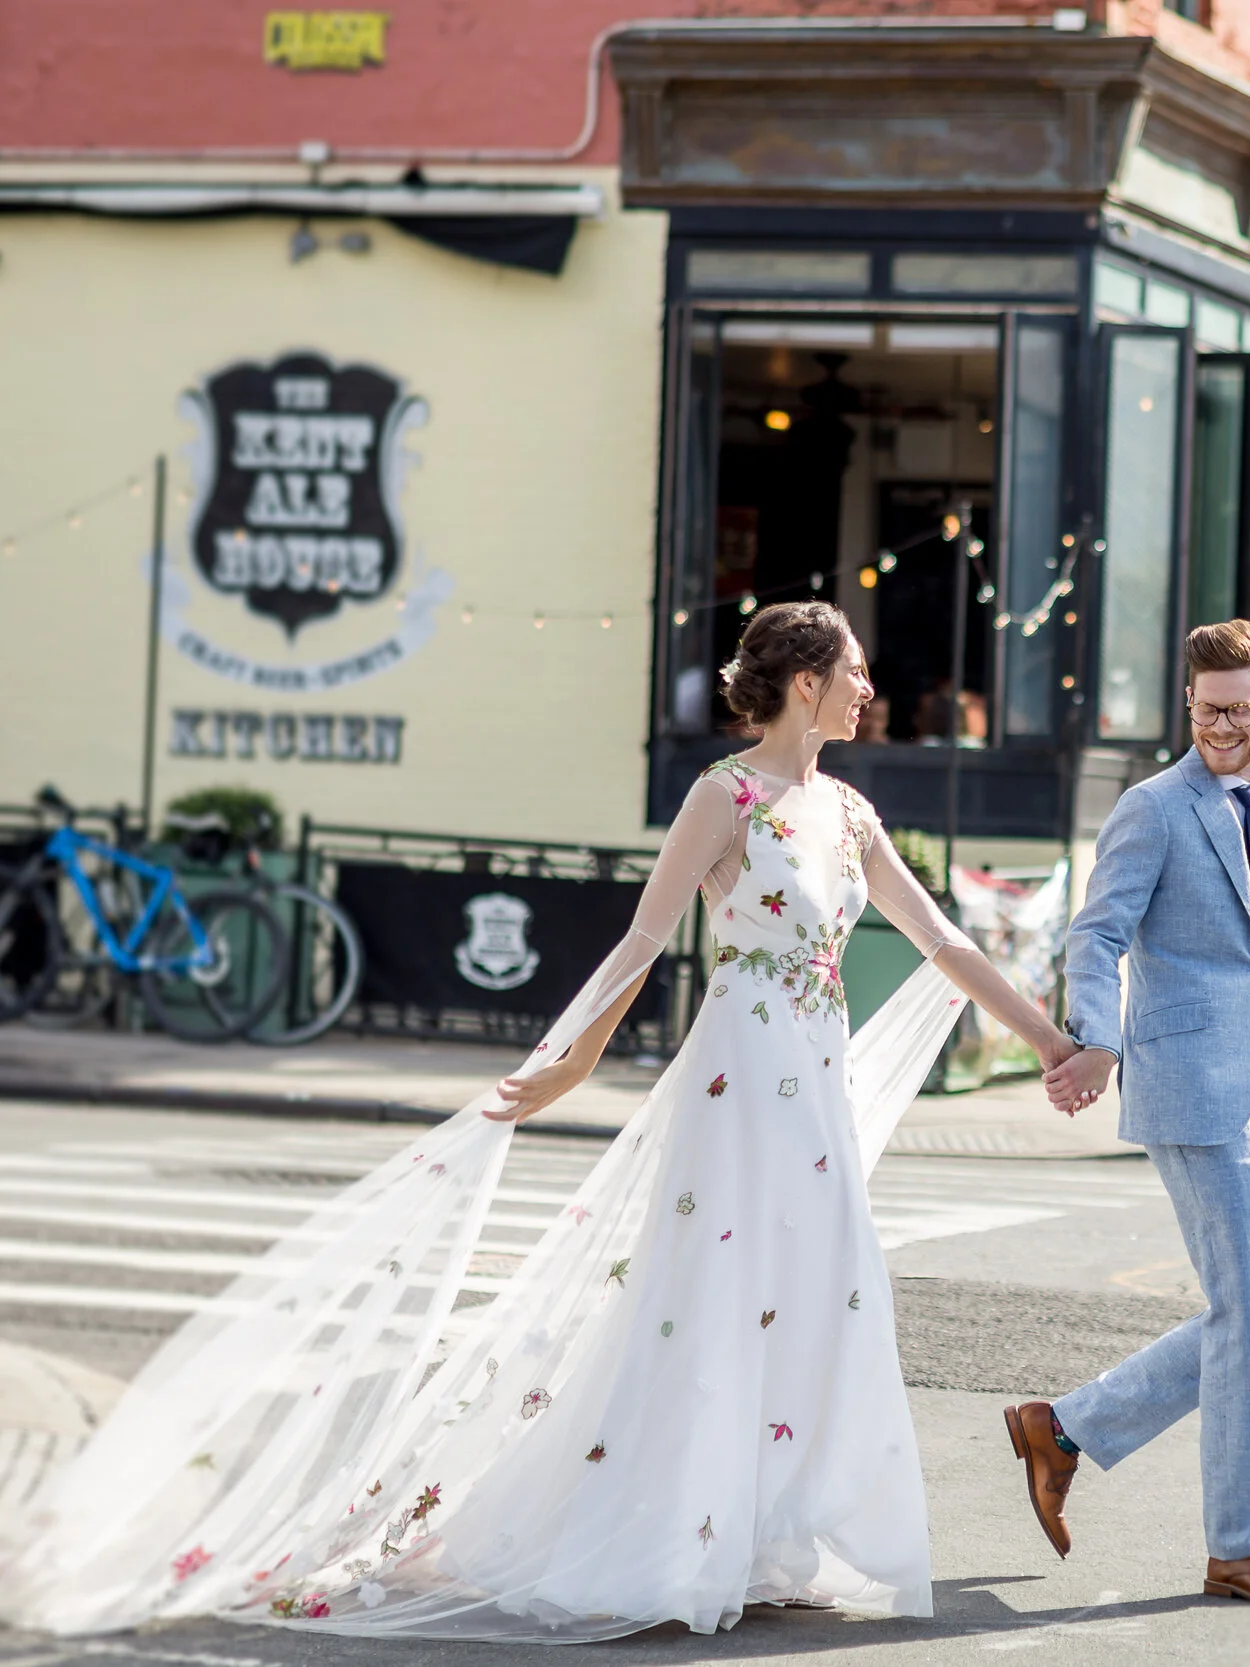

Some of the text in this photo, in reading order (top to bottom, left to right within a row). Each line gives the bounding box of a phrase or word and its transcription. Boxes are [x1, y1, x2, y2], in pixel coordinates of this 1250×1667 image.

[275, 378, 329, 410] THE
[234, 413, 374, 471] KENT
[246, 472, 350, 528] ALE
[214, 531, 382, 592] HOUSE
[179, 631, 404, 691] CRAFT BEER SPIRITS
[169, 707, 406, 766] KITCHEN
